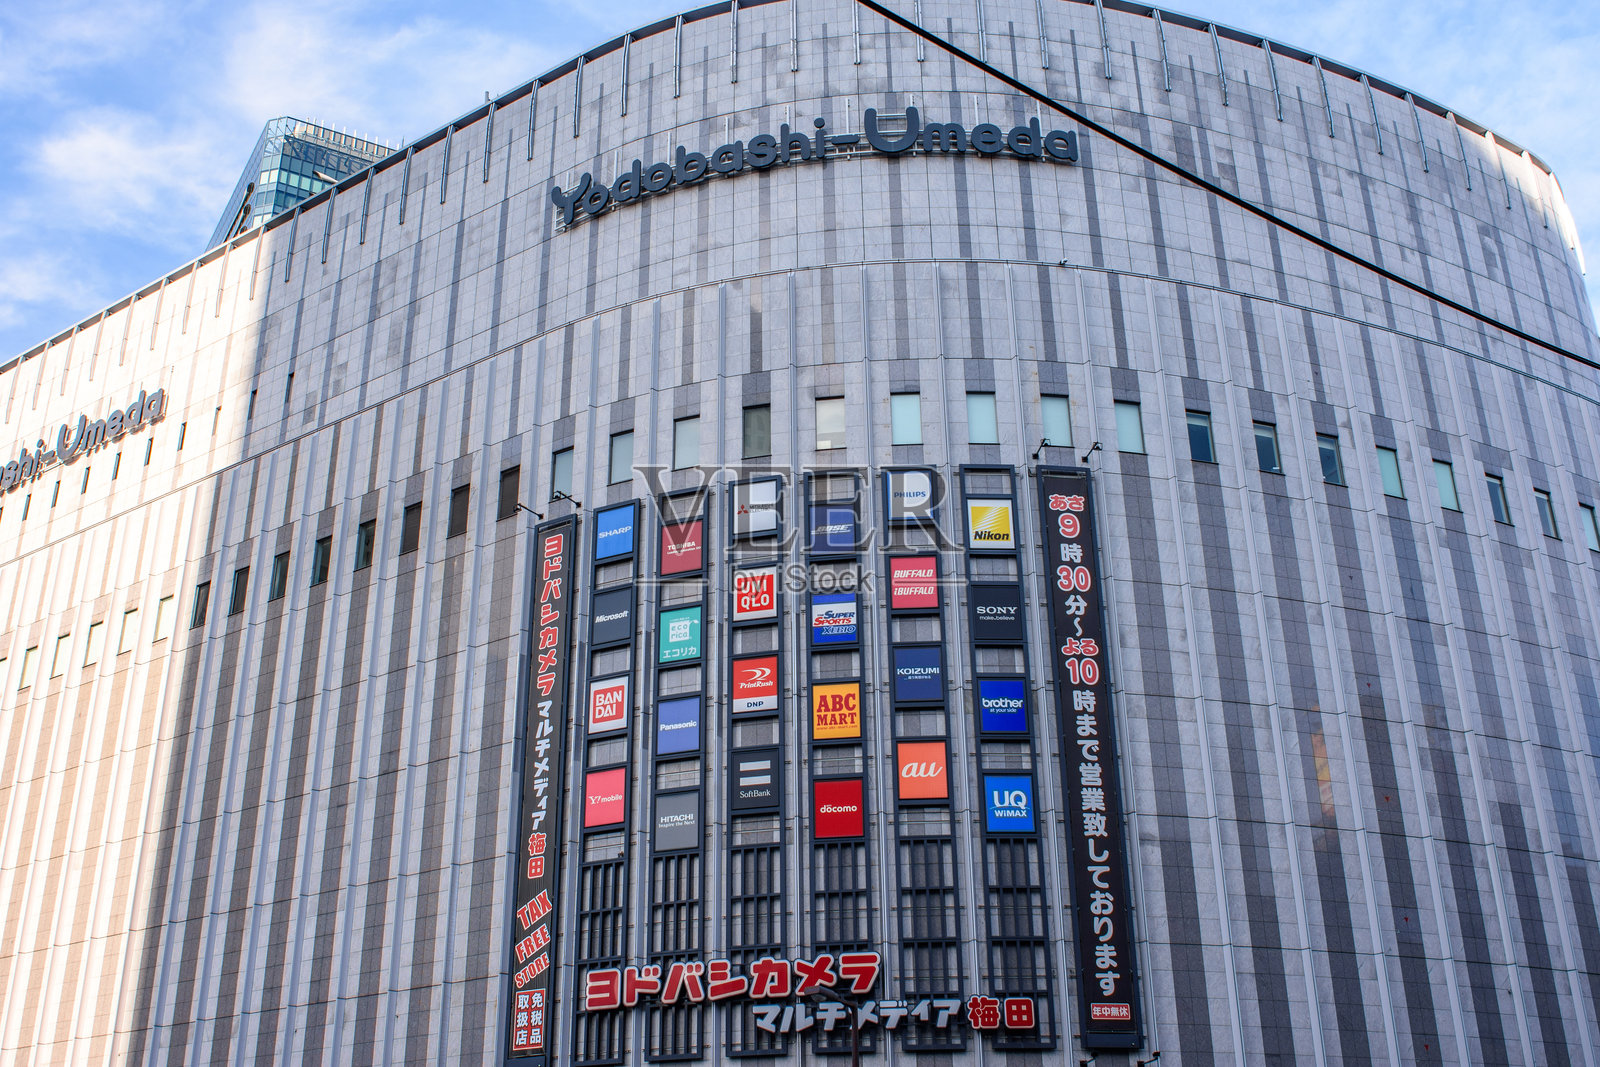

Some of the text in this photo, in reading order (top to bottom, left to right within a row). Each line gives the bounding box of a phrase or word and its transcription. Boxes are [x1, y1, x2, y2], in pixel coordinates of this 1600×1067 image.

[551, 106, 1078, 225] Yodobashi-Umeda
[598, 525, 632, 539] SHARP
[974, 531, 1009, 541] Nikon
[667, 541, 696, 551] TOSHIBA
[894, 569, 934, 579] BUFFALO
[741, 579, 767, 594] UNI
[894, 586, 934, 596] iBUFFALO
[741, 594, 770, 610] QLO
[824, 610, 855, 619] SUPER
[976, 606, 1017, 614] SONY
[595, 610, 629, 623] Microsoft
[814, 616, 852, 626] SPORTS
[671, 623, 688, 631] eco
[663, 646, 697, 658] エコリカ
[897, 667, 940, 675] KOIZUMI
[739, 680, 773, 689] PrintRush
[596, 690, 622, 706] BAN
[816, 693, 857, 713] ABC
[982, 698, 1023, 708] brother
[746, 700, 764, 708] DNP
[595, 704, 616, 719] DAI
[816, 712, 857, 726] MART
[660, 720, 697, 731] Panasonic
[902, 762, 943, 778] au
[739, 789, 771, 799] SoftBank
[993, 790, 1027, 807] UQ
[660, 813, 694, 823] HITACHI
[516, 888, 553, 931] TAX
[515, 923, 551, 964] FREE
[514, 951, 551, 989] STORE
[586, 951, 882, 1011] ヨドバシカメラ
[1092, 1006, 1129, 1017] 年中無休
